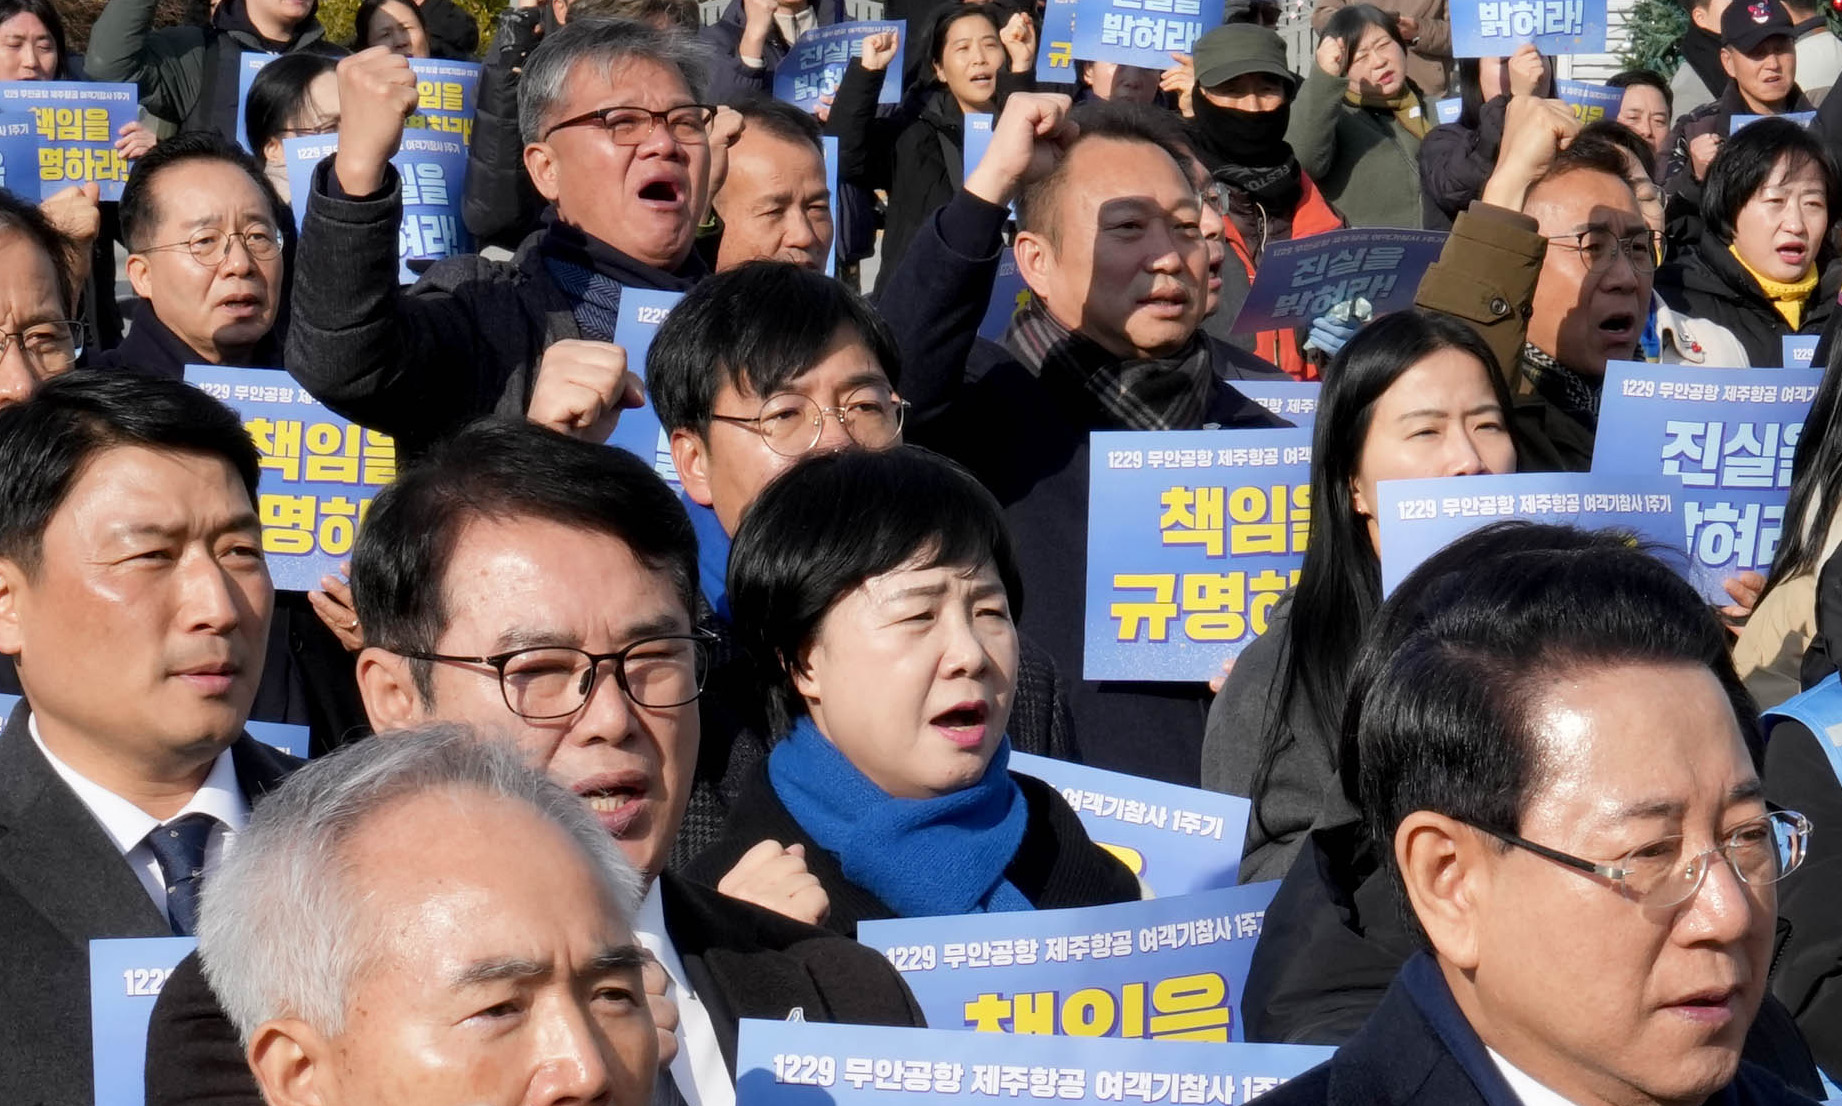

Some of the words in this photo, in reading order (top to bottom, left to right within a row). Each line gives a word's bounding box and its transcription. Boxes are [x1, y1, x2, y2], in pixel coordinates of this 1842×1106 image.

[1478, 0, 1585, 38] 밝혀라!
[416, 81, 464, 111] 임을
[38, 147, 130, 182] 명하라!
[1292, 246, 1405, 288] 진실을
[234, 384, 294, 403] 무안공항
[1286, 397, 1318, 414] 제주
[1622, 378, 1655, 399] 1229
[1658, 380, 1720, 401] 무안공항
[1721, 384, 1777, 402] 제주항공
[1780, 386, 1819, 404] 여객기
[1108, 450, 1143, 469] 1229
[1147, 449, 1213, 469] 무안공항
[1217, 446, 1278, 467] 제주항공
[1397, 498, 1437, 520] 1229
[1441, 494, 1516, 518] 무안공항
[1518, 492, 1581, 514] 제주항공
[1583, 492, 1643, 513] 여객기참사
[1644, 493, 1673, 513] 1주기
[1062, 786, 1168, 829] 여객기참사
[1171, 808, 1224, 841] 1주기
[886, 943, 937, 972] 1229
[942, 937, 1039, 971] 무안공항
[1044, 929, 1133, 965] 제주항공
[1137, 913, 1232, 954] 여객기참사
[964, 971, 1233, 1044] 책임을
[773, 1052, 837, 1089] 1229
[843, 1060, 964, 1099] 무안공항
[970, 1065, 1087, 1103] 제주항공
[1095, 1070, 1235, 1106] 여객기참사
